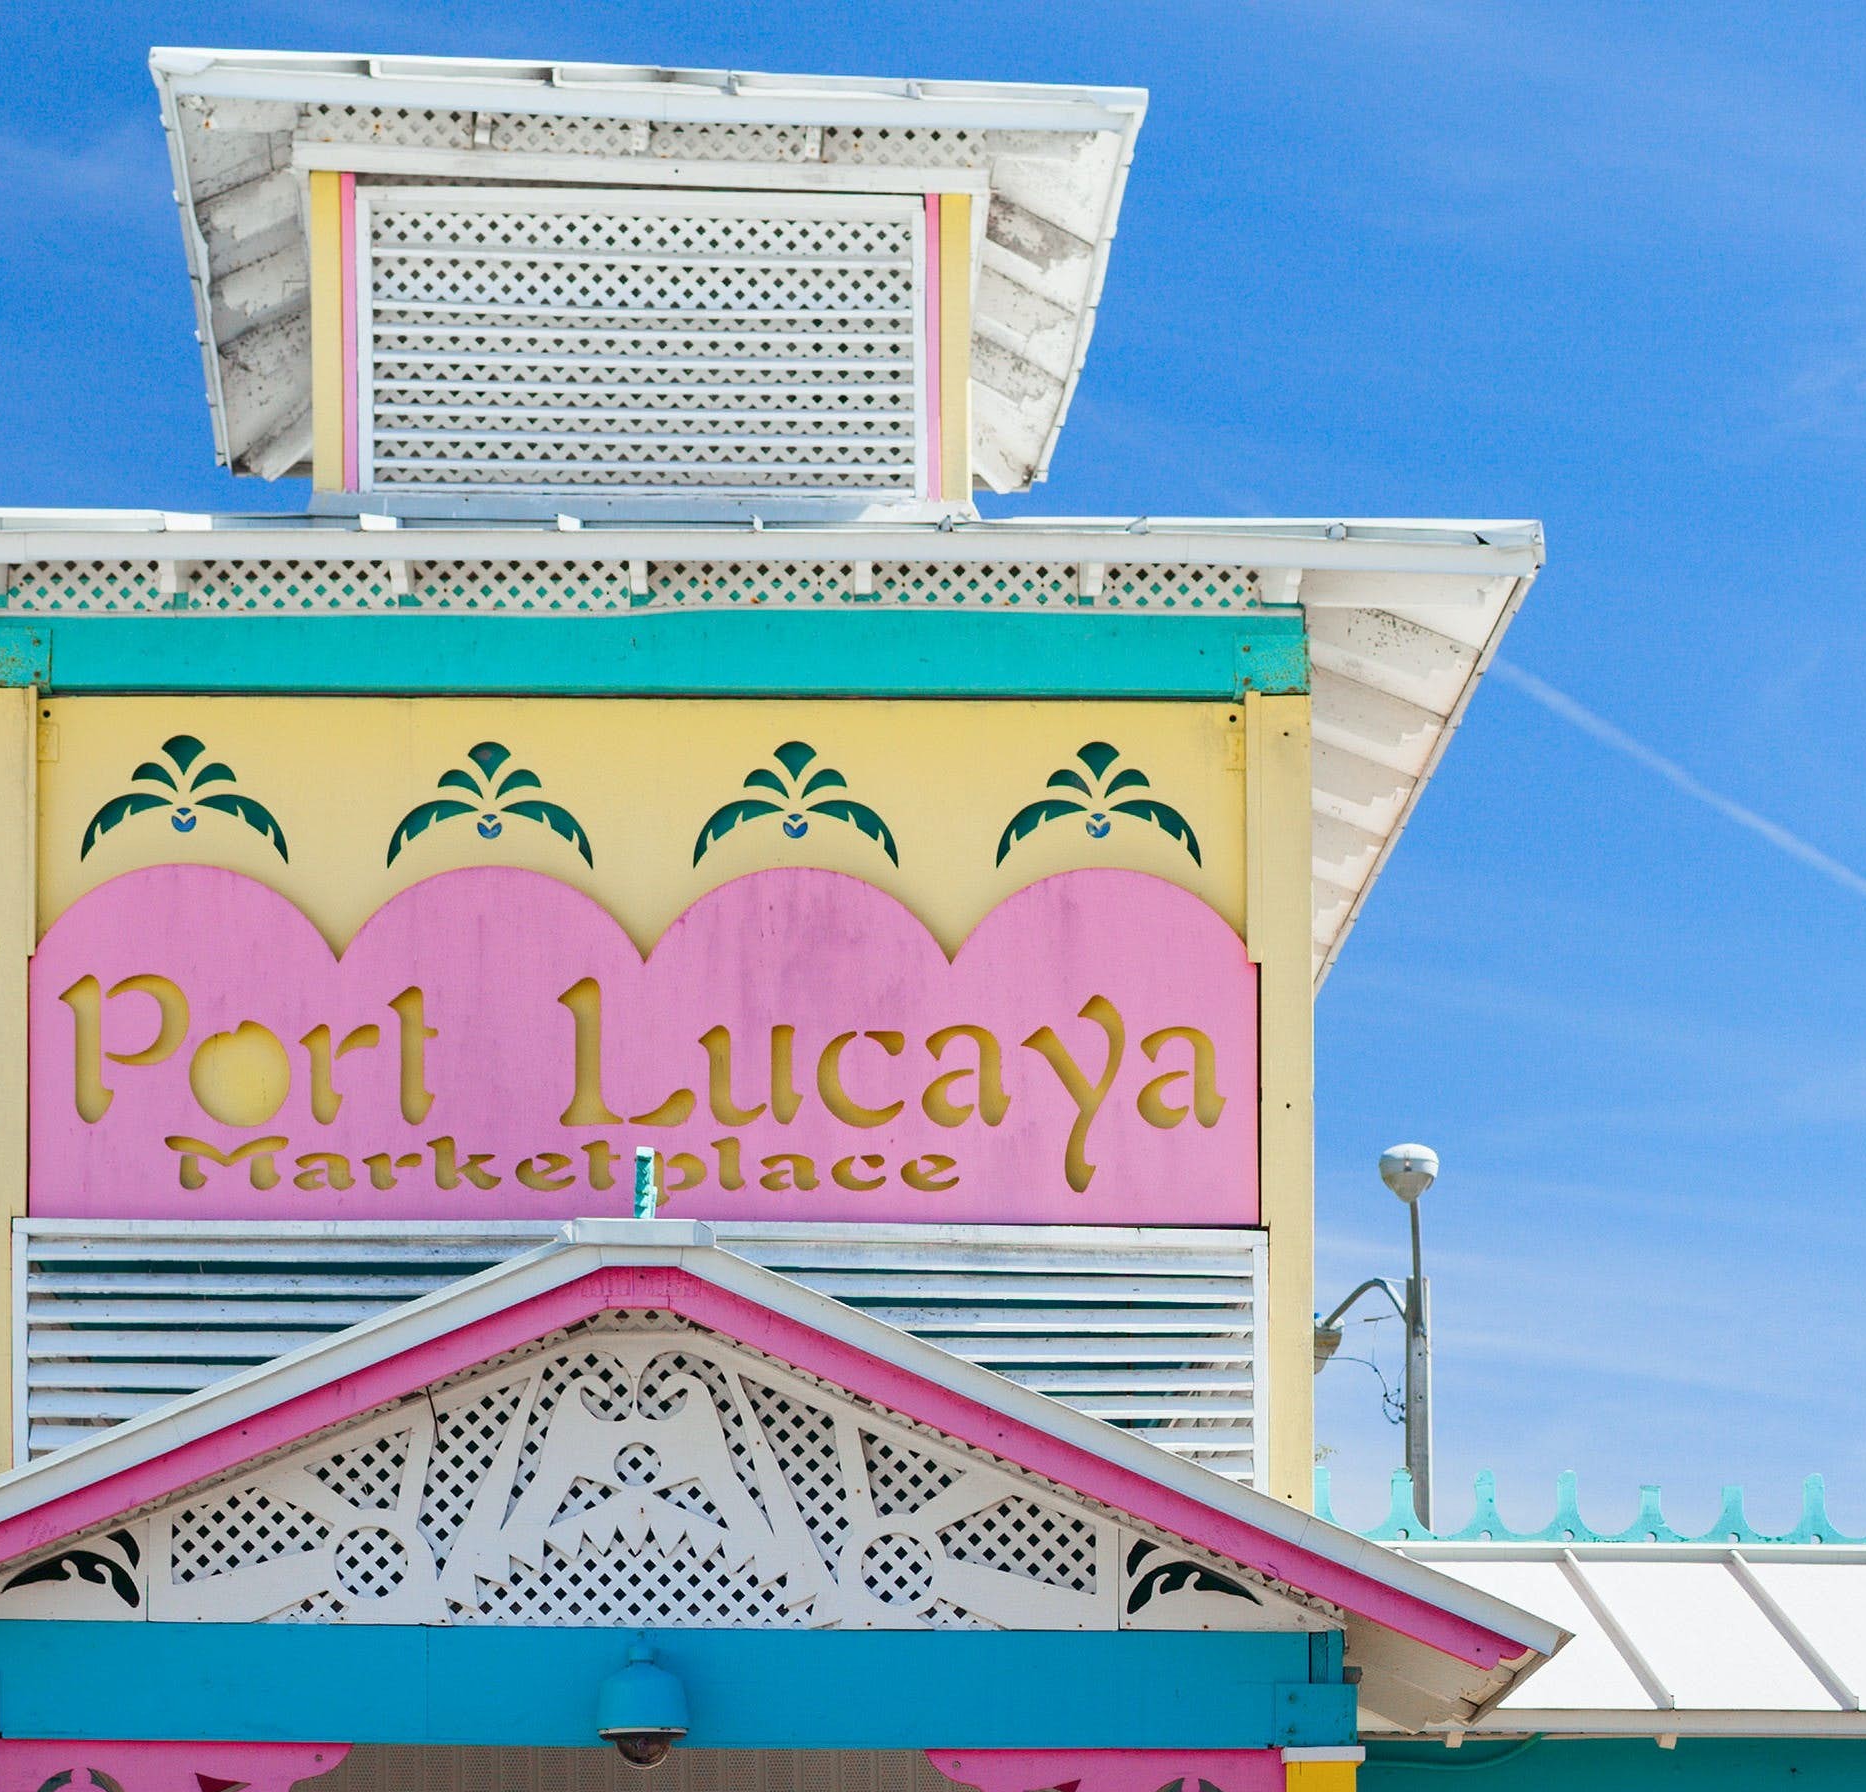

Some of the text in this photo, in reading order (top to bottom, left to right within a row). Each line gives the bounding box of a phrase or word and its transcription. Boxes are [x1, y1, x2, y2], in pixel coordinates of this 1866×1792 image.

[59, 973, 1223, 1193] Port Lucaya
[164, 1135, 959, 1205] Marketplace
